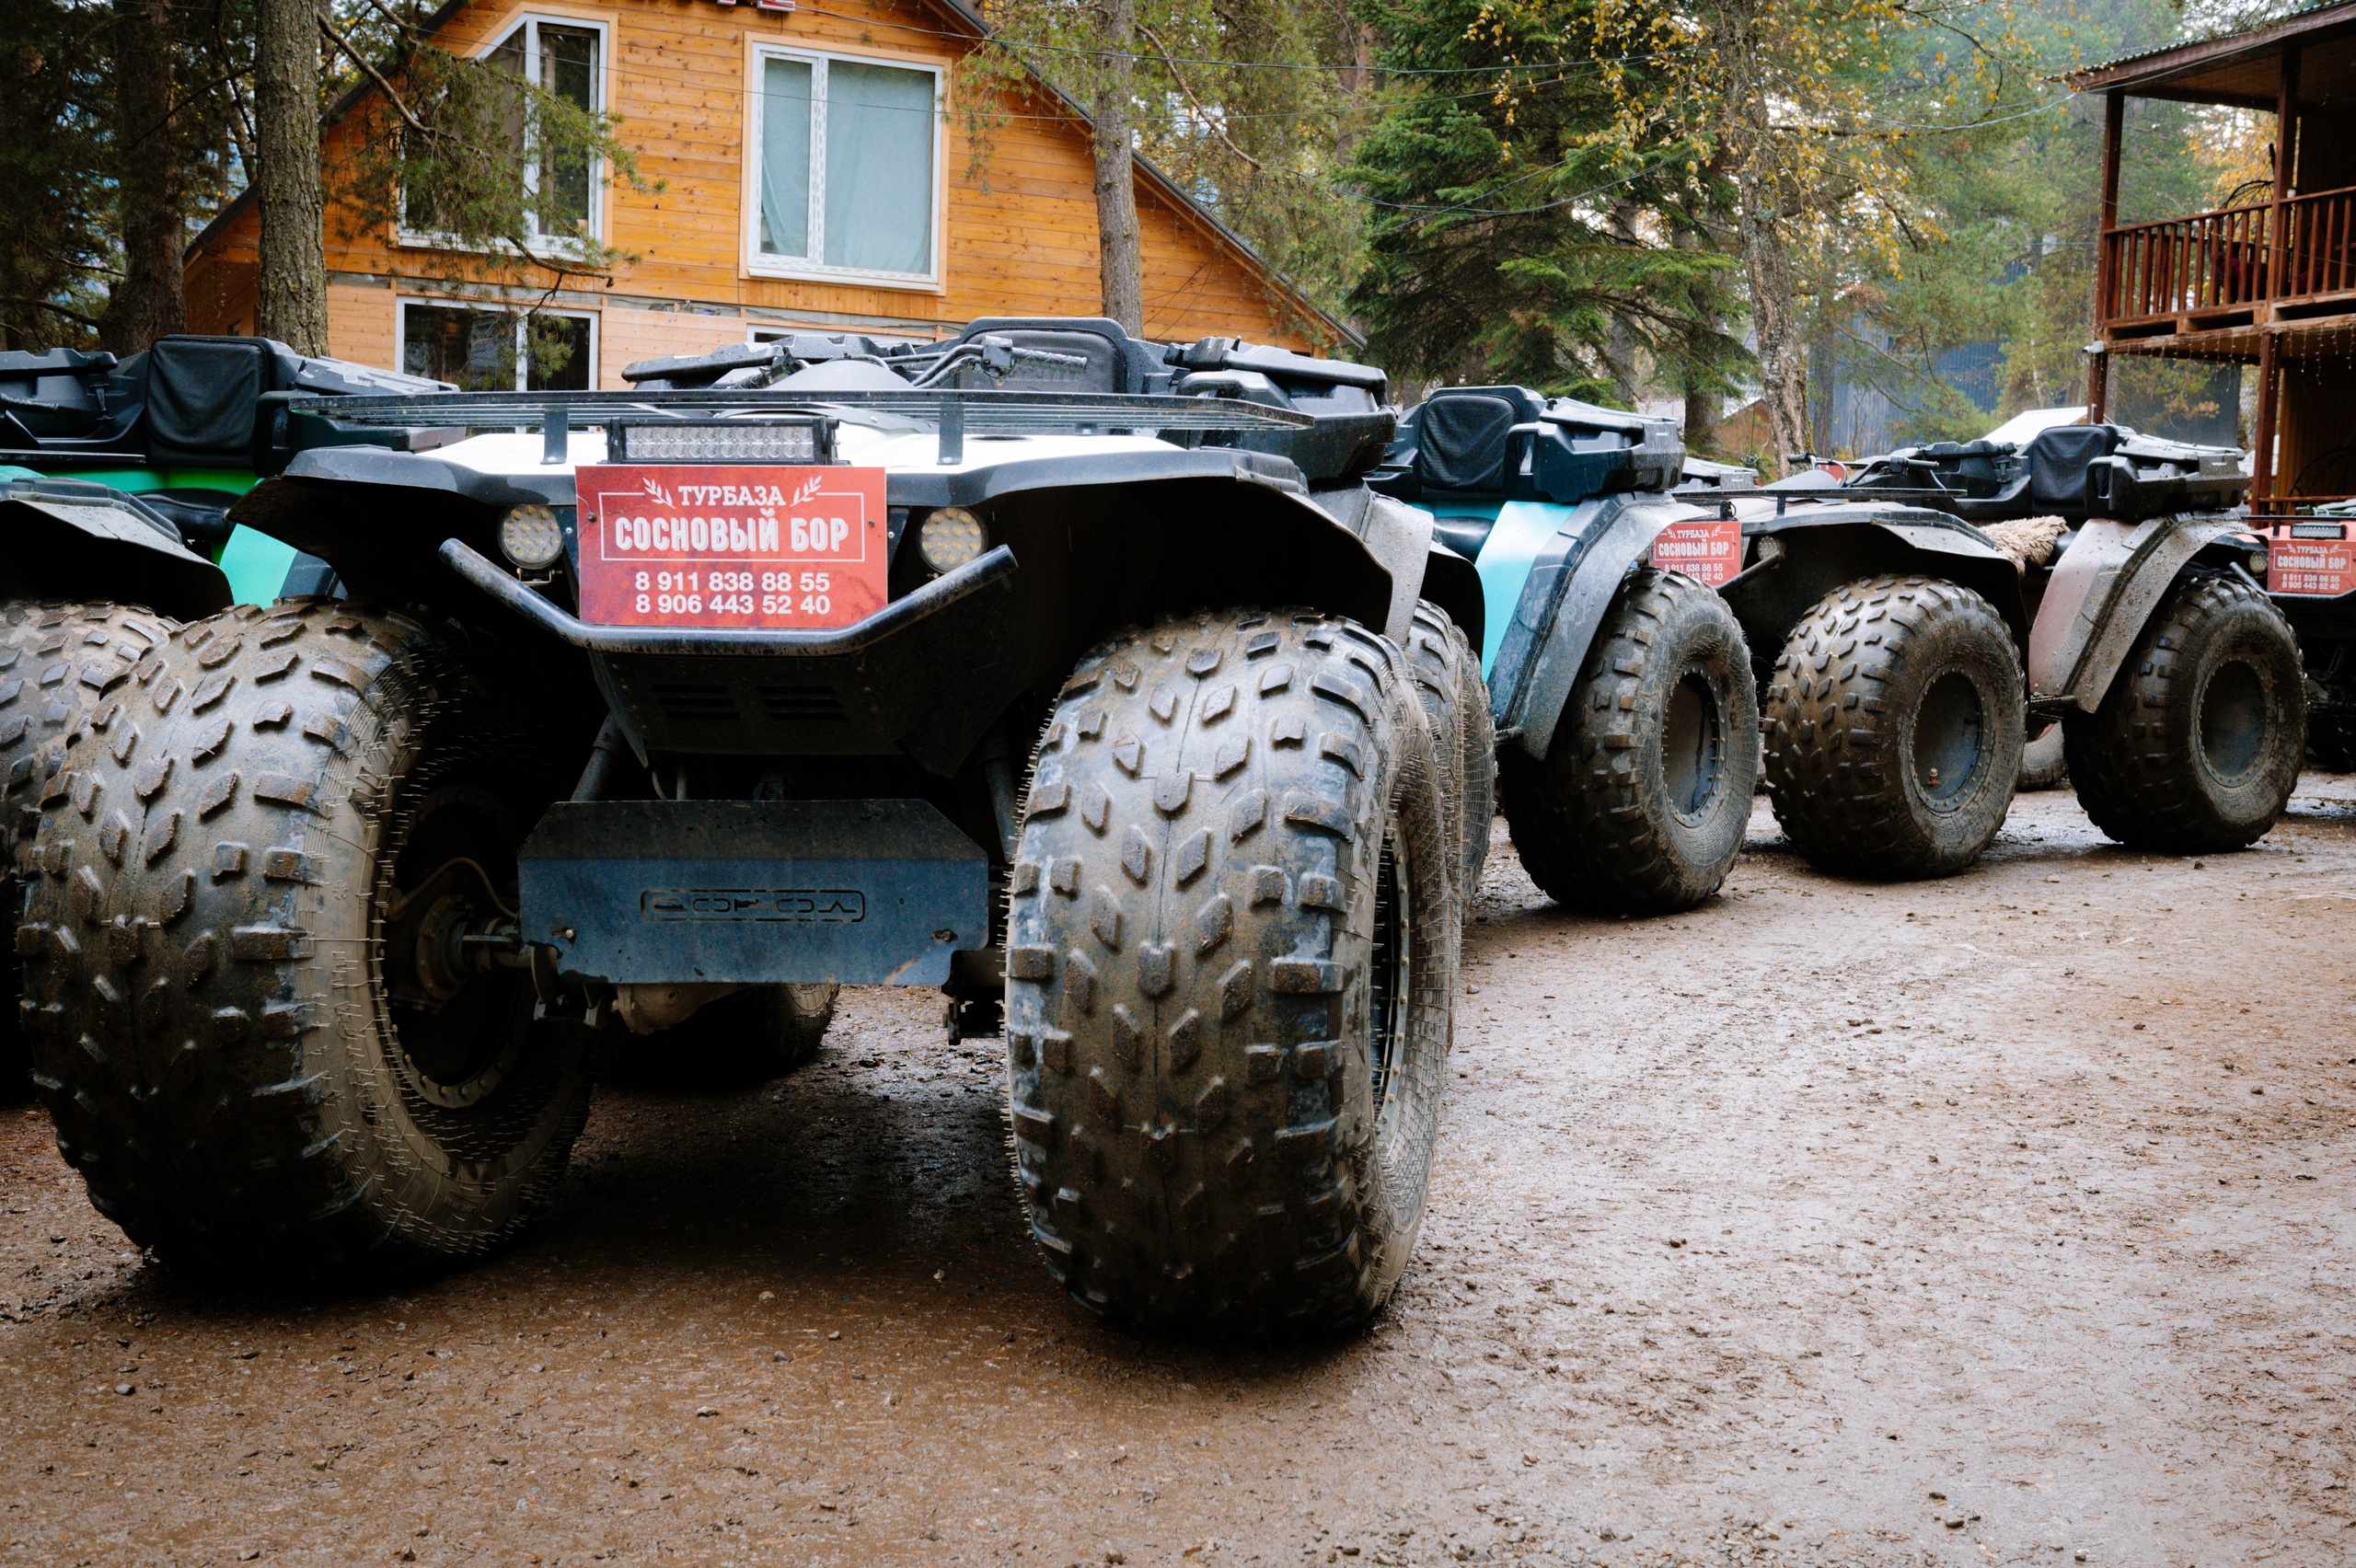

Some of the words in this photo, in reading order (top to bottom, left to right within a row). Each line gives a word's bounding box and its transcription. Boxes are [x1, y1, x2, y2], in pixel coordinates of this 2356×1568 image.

[678, 486, 786, 506] ТУРБАЗА
[615, 508, 779, 552] СОСНОВЫЙ
[790, 517, 849, 552] БОР
[1677, 529, 1710, 538] ТУРБАЗА
[1658, 538, 1708, 557] СОСНОВЫЙ
[1710, 541, 1729, 557] БОР
[2296, 546, 2328, 554] ТУРБАЗА
[1671, 564, 1684, 572] 911
[1713, 563, 1723, 571] 55
[2278, 554, 2326, 569] СОСНОВЫЙ
[2328, 558, 2346, 570] БОР
[636, 571, 650, 591] 8
[657, 571, 699, 591] 911
[709, 571, 754, 591] 838
[762, 571, 792, 591] 88
[800, 571, 830, 591] 55
[1713, 572, 1724, 581] 40
[2289, 573, 2302, 582] 911
[636, 594, 651, 614] 8
[657, 594, 702, 614] 906
[709, 594, 755, 614] 443
[762, 594, 792, 614] 52
[800, 594, 830, 614] 40
